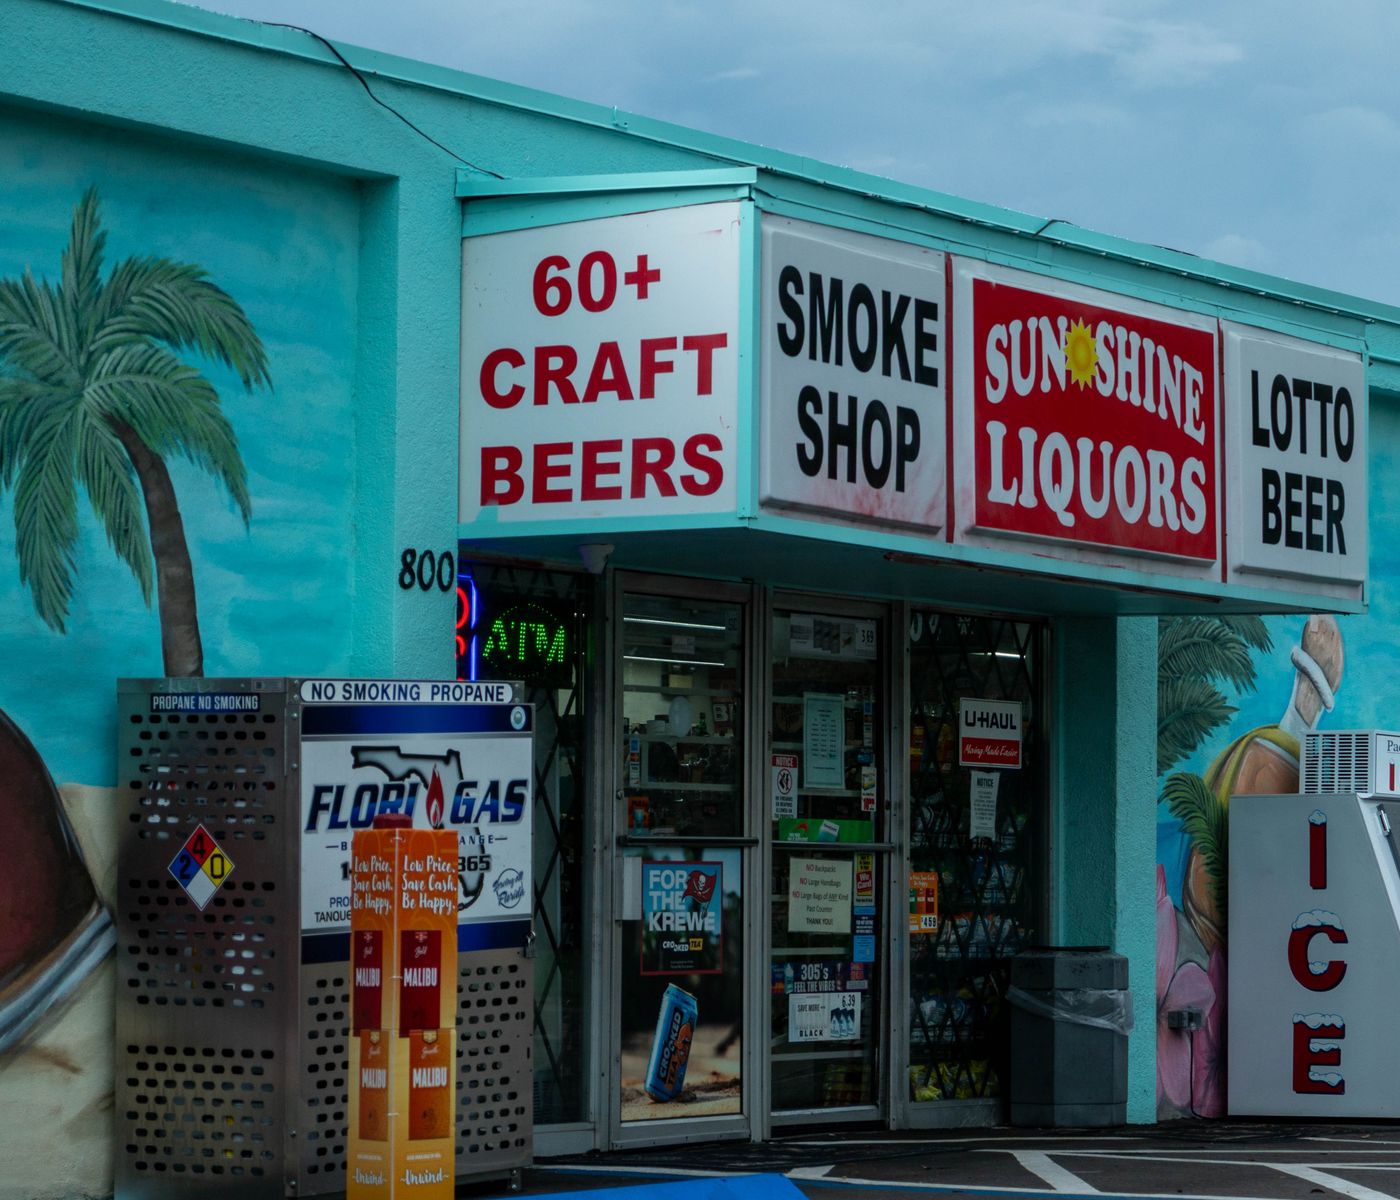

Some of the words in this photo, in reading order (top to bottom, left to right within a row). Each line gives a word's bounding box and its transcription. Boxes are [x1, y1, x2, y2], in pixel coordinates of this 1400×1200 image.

[533, 250, 660, 317] 60+
[777, 265, 939, 387] SMOKE
[480, 333, 727, 409] CRAFT
[1251, 370, 1355, 463] LOTTO
[797, 386, 920, 493] SHOP
[480, 433, 724, 506] BEERS
[986, 421, 1207, 534] LIQUORS
[1262, 469, 1347, 556] BEER
[399, 548, 454, 592] 800
[482, 619, 565, 663] ATM
[152, 696, 196, 710] PROPANE
[198, 696, 212, 710] NO
[214, 695, 259, 710] SMOKING
[311, 683, 336, 701] NO
[342, 683, 420, 701] SMOKING
[431, 685, 505, 702] PROPANE
[965, 710, 1017, 729] U-HAUL
[977, 777, 994, 788] NOTICE
[450, 780, 528, 825] GAS
[192, 833, 205, 858] 4
[179, 854, 191, 880] 2
[210, 854, 225, 879] 0
[354, 855, 370, 873] Low
[370, 855, 393, 873] Price.
[403, 854, 424, 873] Low
[426, 854, 456, 873] Price.
[353, 873, 370, 892] Save
[371, 874, 393, 891] Cash.
[402, 873, 425, 892] Save
[428, 873, 457, 891] Cash.
[649, 869, 688, 890] FOR
[353, 893, 363, 910] Be
[364, 895, 393, 917] Happy.
[402, 892, 416, 909] Be
[419, 893, 456, 916] Happy.
[648, 891, 686, 911] THE
[648, 911, 716, 932] KREWE
[1287, 809, 1348, 1096] ICE
[355, 967, 381, 987] MALIBU
[403, 967, 438, 987] MALIBU
[800, 962, 829, 980] 305's
[659, 1012, 682, 1078] CROOKED
[361, 1067, 387, 1089] MALIBU
[412, 1066, 448, 1089] MALIBU
[405, 1167, 442, 1185] Unwind
